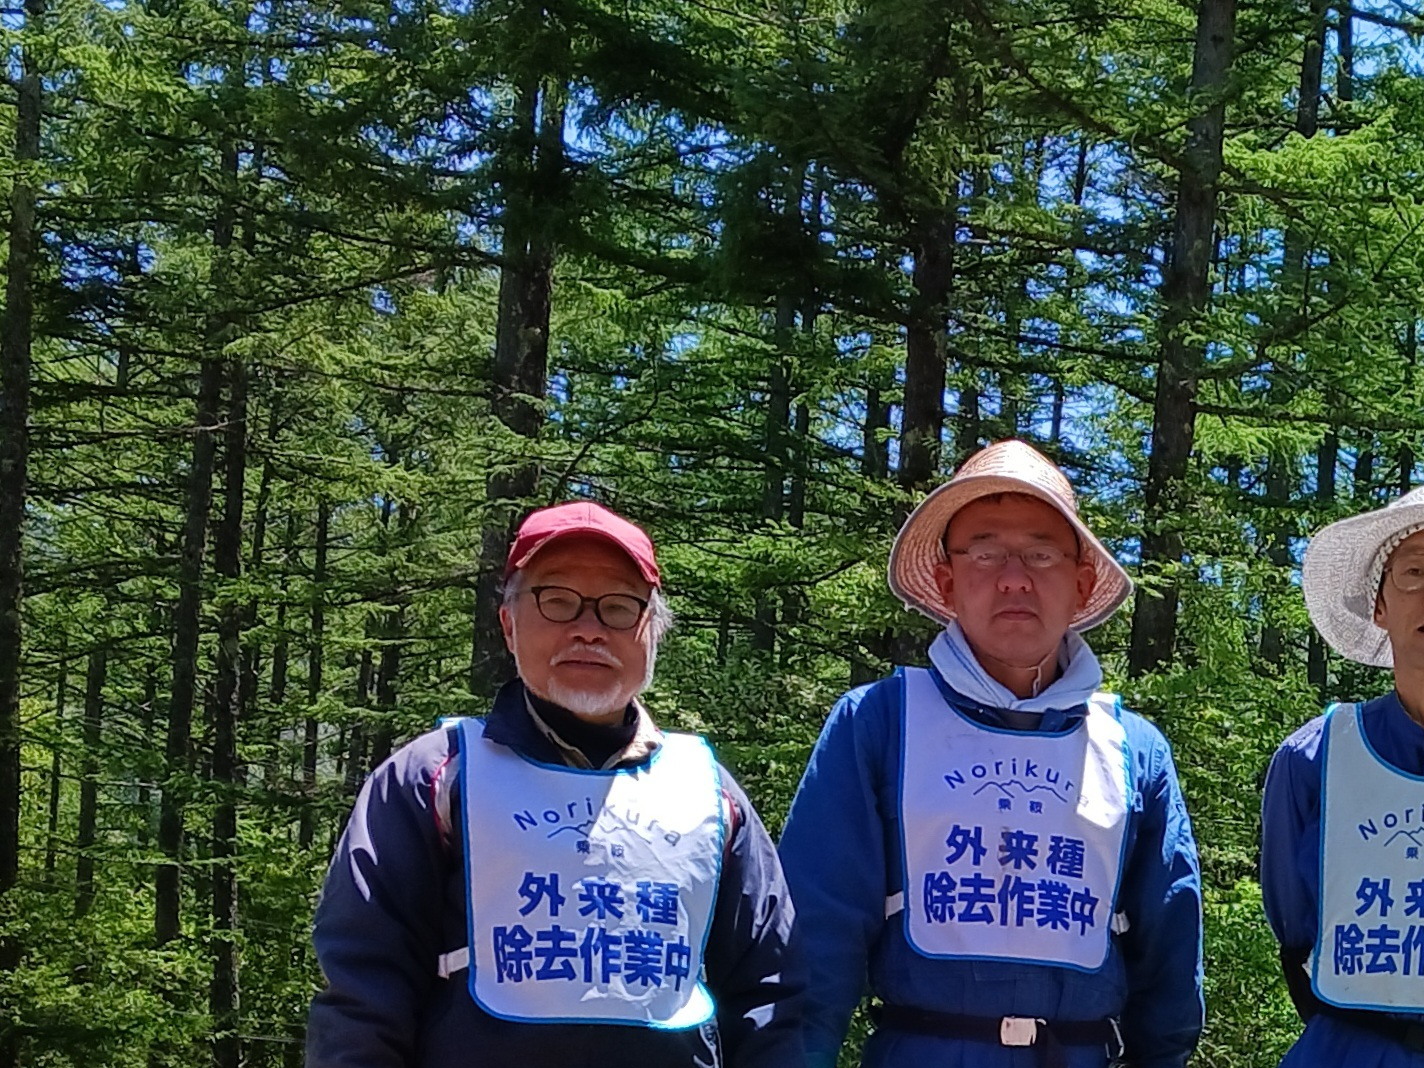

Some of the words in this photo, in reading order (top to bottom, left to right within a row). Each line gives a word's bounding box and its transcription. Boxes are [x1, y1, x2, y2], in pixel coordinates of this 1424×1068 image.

[513, 798, 681, 847] Norikura
[946, 824, 1085, 879] 外来種
[518, 872, 679, 925] 外来種
[923, 871, 1099, 936] 除去作業中
[493, 925, 692, 992] 除去作業中
